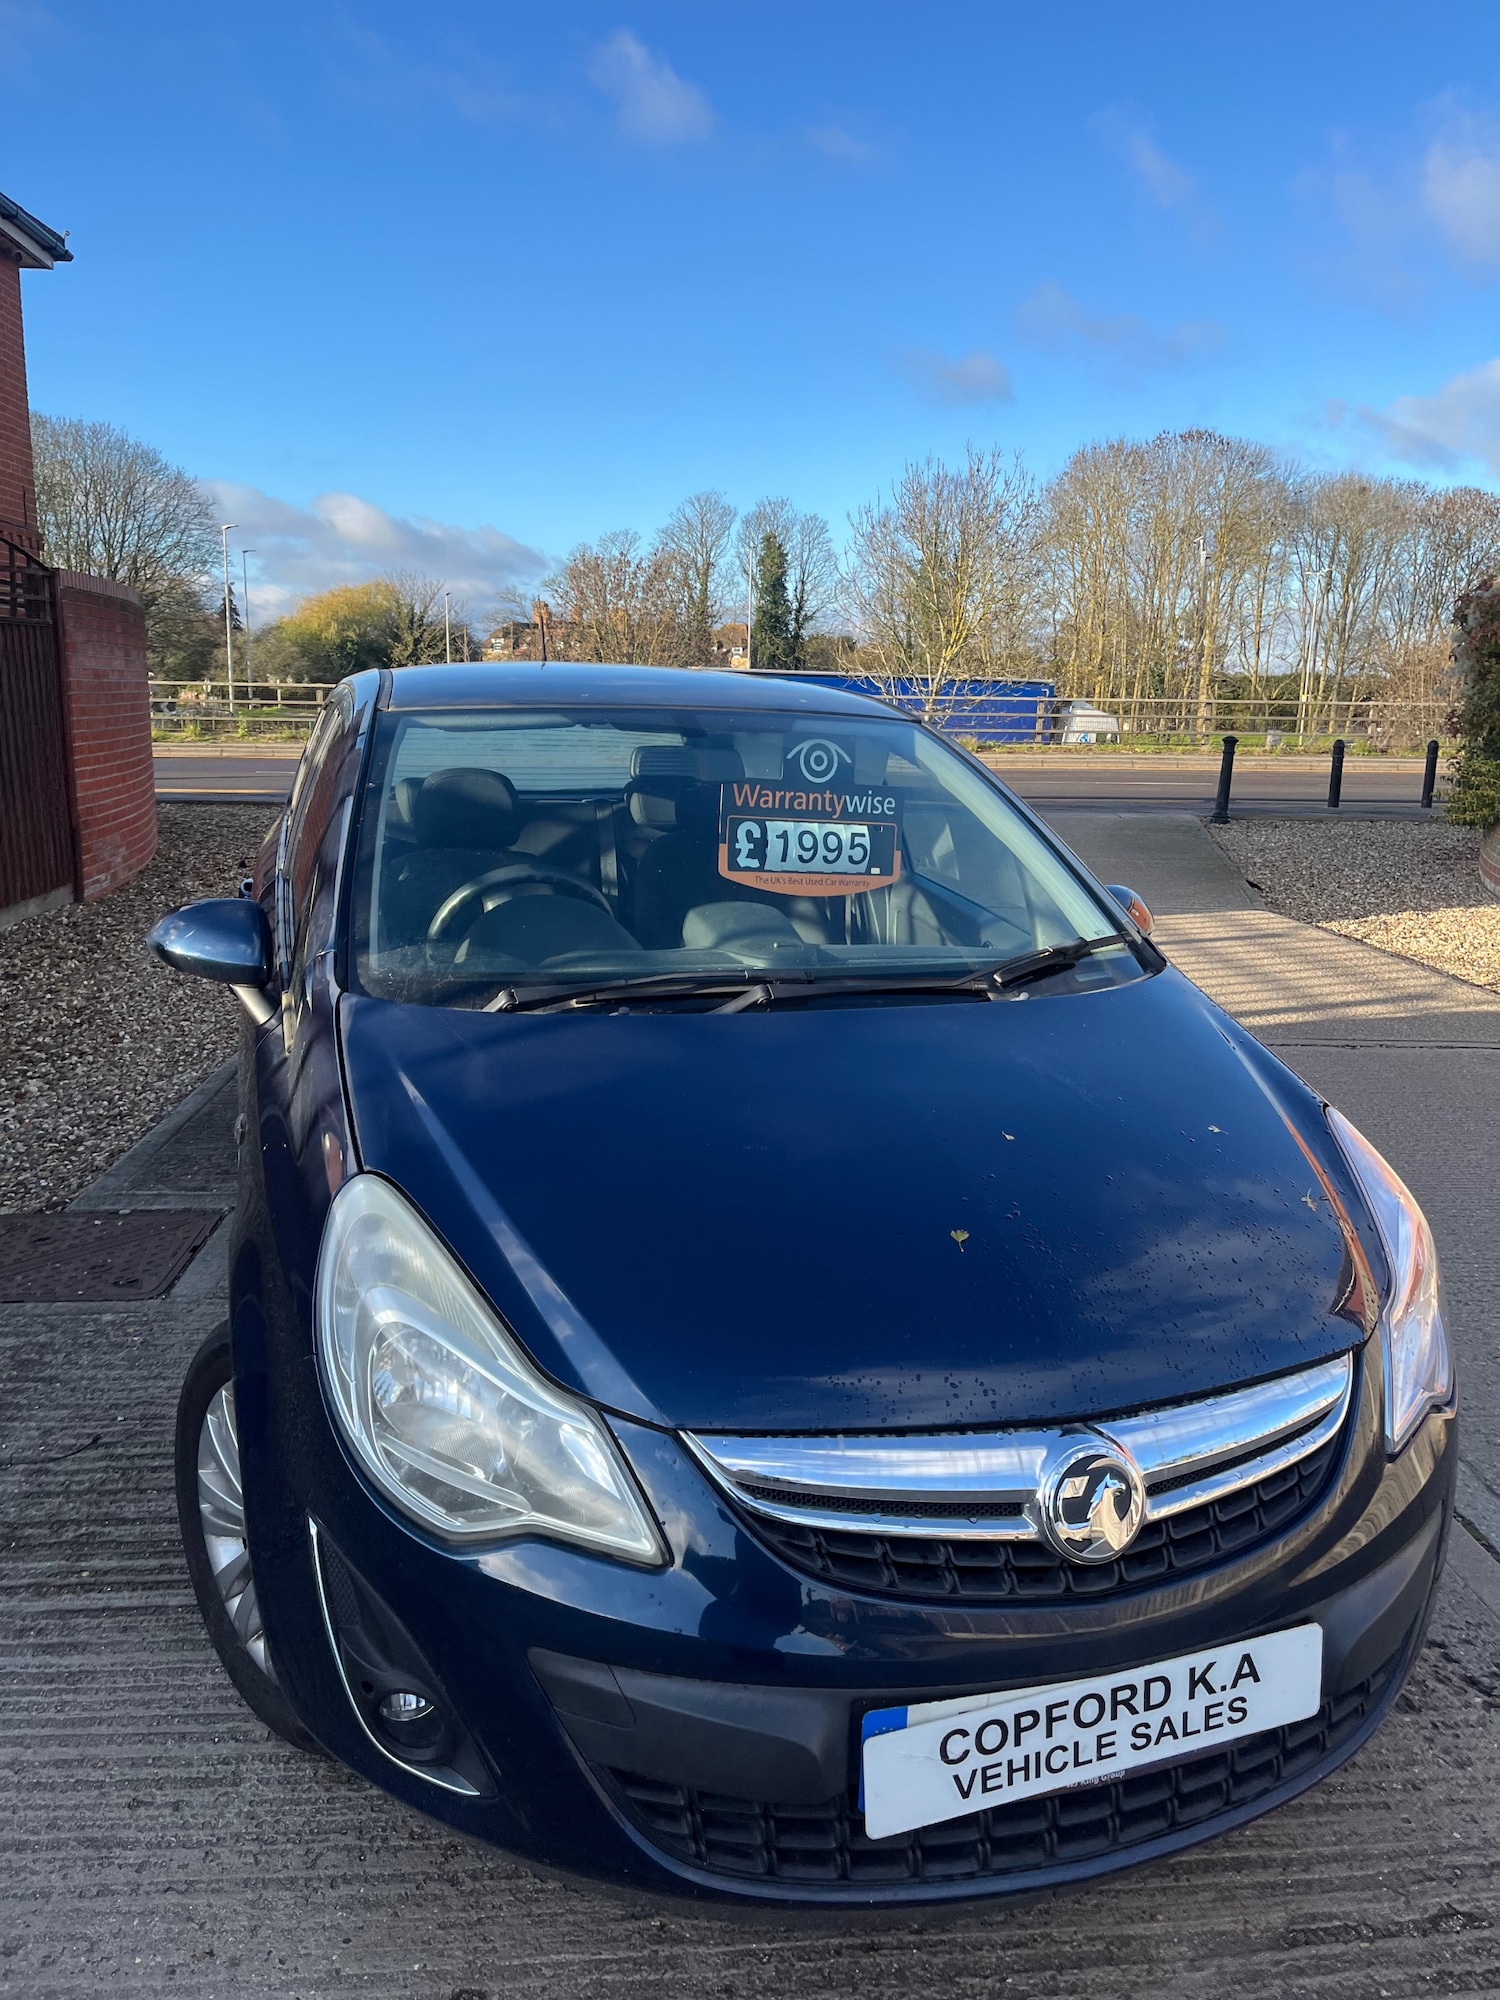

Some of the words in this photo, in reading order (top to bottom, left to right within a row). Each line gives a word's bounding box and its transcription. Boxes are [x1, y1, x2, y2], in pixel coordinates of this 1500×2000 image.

[732, 783, 896, 819] Warrantywise
[735, 820, 869, 869] £1995
[755, 875, 769, 885] The
[770, 876, 786, 885] UK's
[788, 877, 804, 886] Best
[805, 877, 824, 886] Used
[825, 878, 837, 886] Car
[837, 878, 870, 888] Warranty
[939, 1674, 1172, 1766] COPFORD
[1188, 1652, 1262, 1701] K.A
[952, 1730, 1118, 1800] VEHICLE
[1129, 1696, 1249, 1751] SALES
